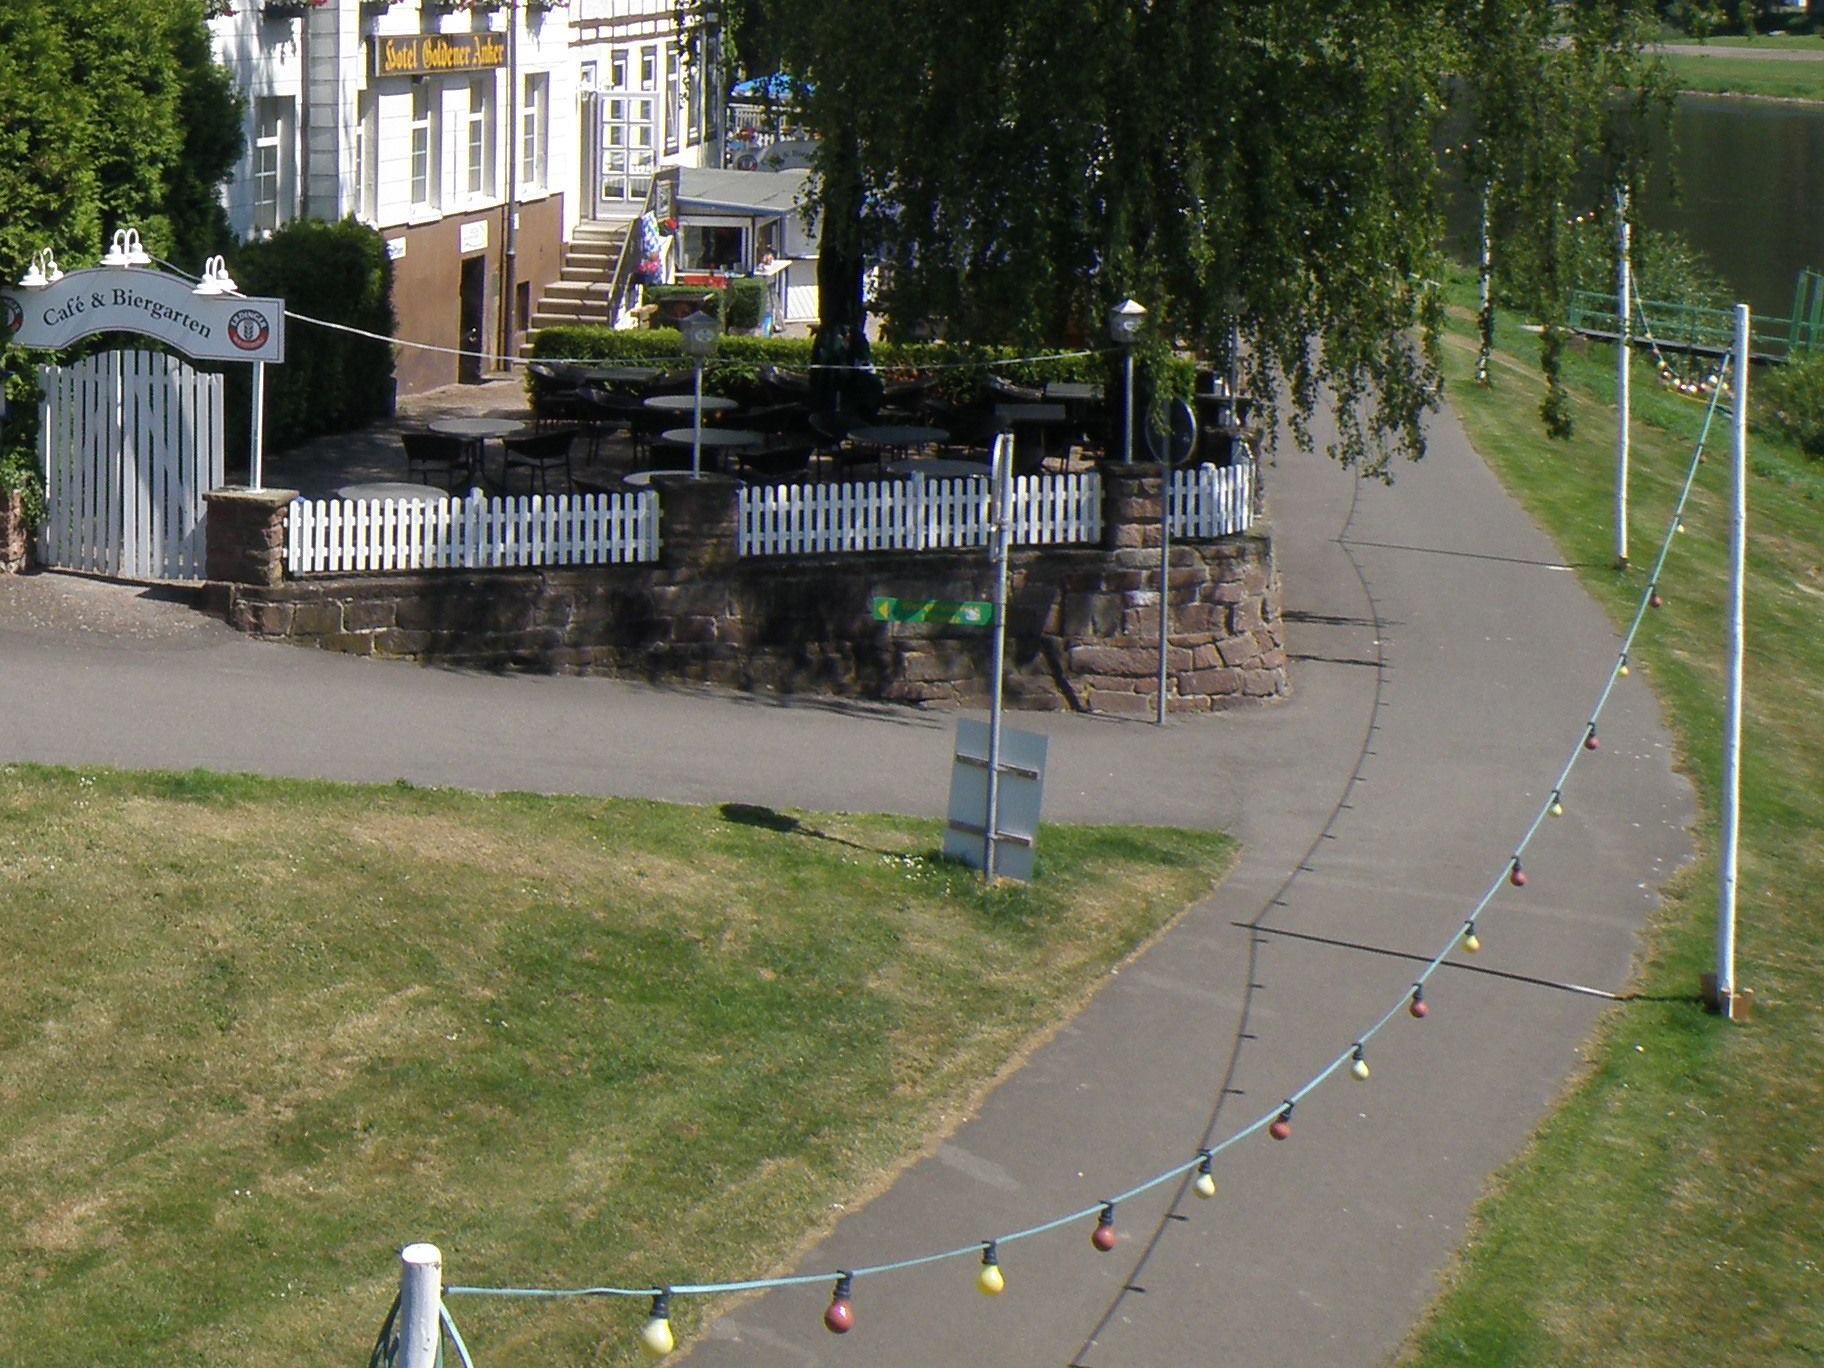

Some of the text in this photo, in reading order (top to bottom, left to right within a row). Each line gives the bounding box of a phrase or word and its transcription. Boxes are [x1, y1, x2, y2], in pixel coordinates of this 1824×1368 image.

[385, 35, 504, 70] Hotel Goldener Anker
[43, 296, 85, 326] Café
[91, 292, 106, 308] &
[112, 288, 212, 339] Biergarten
